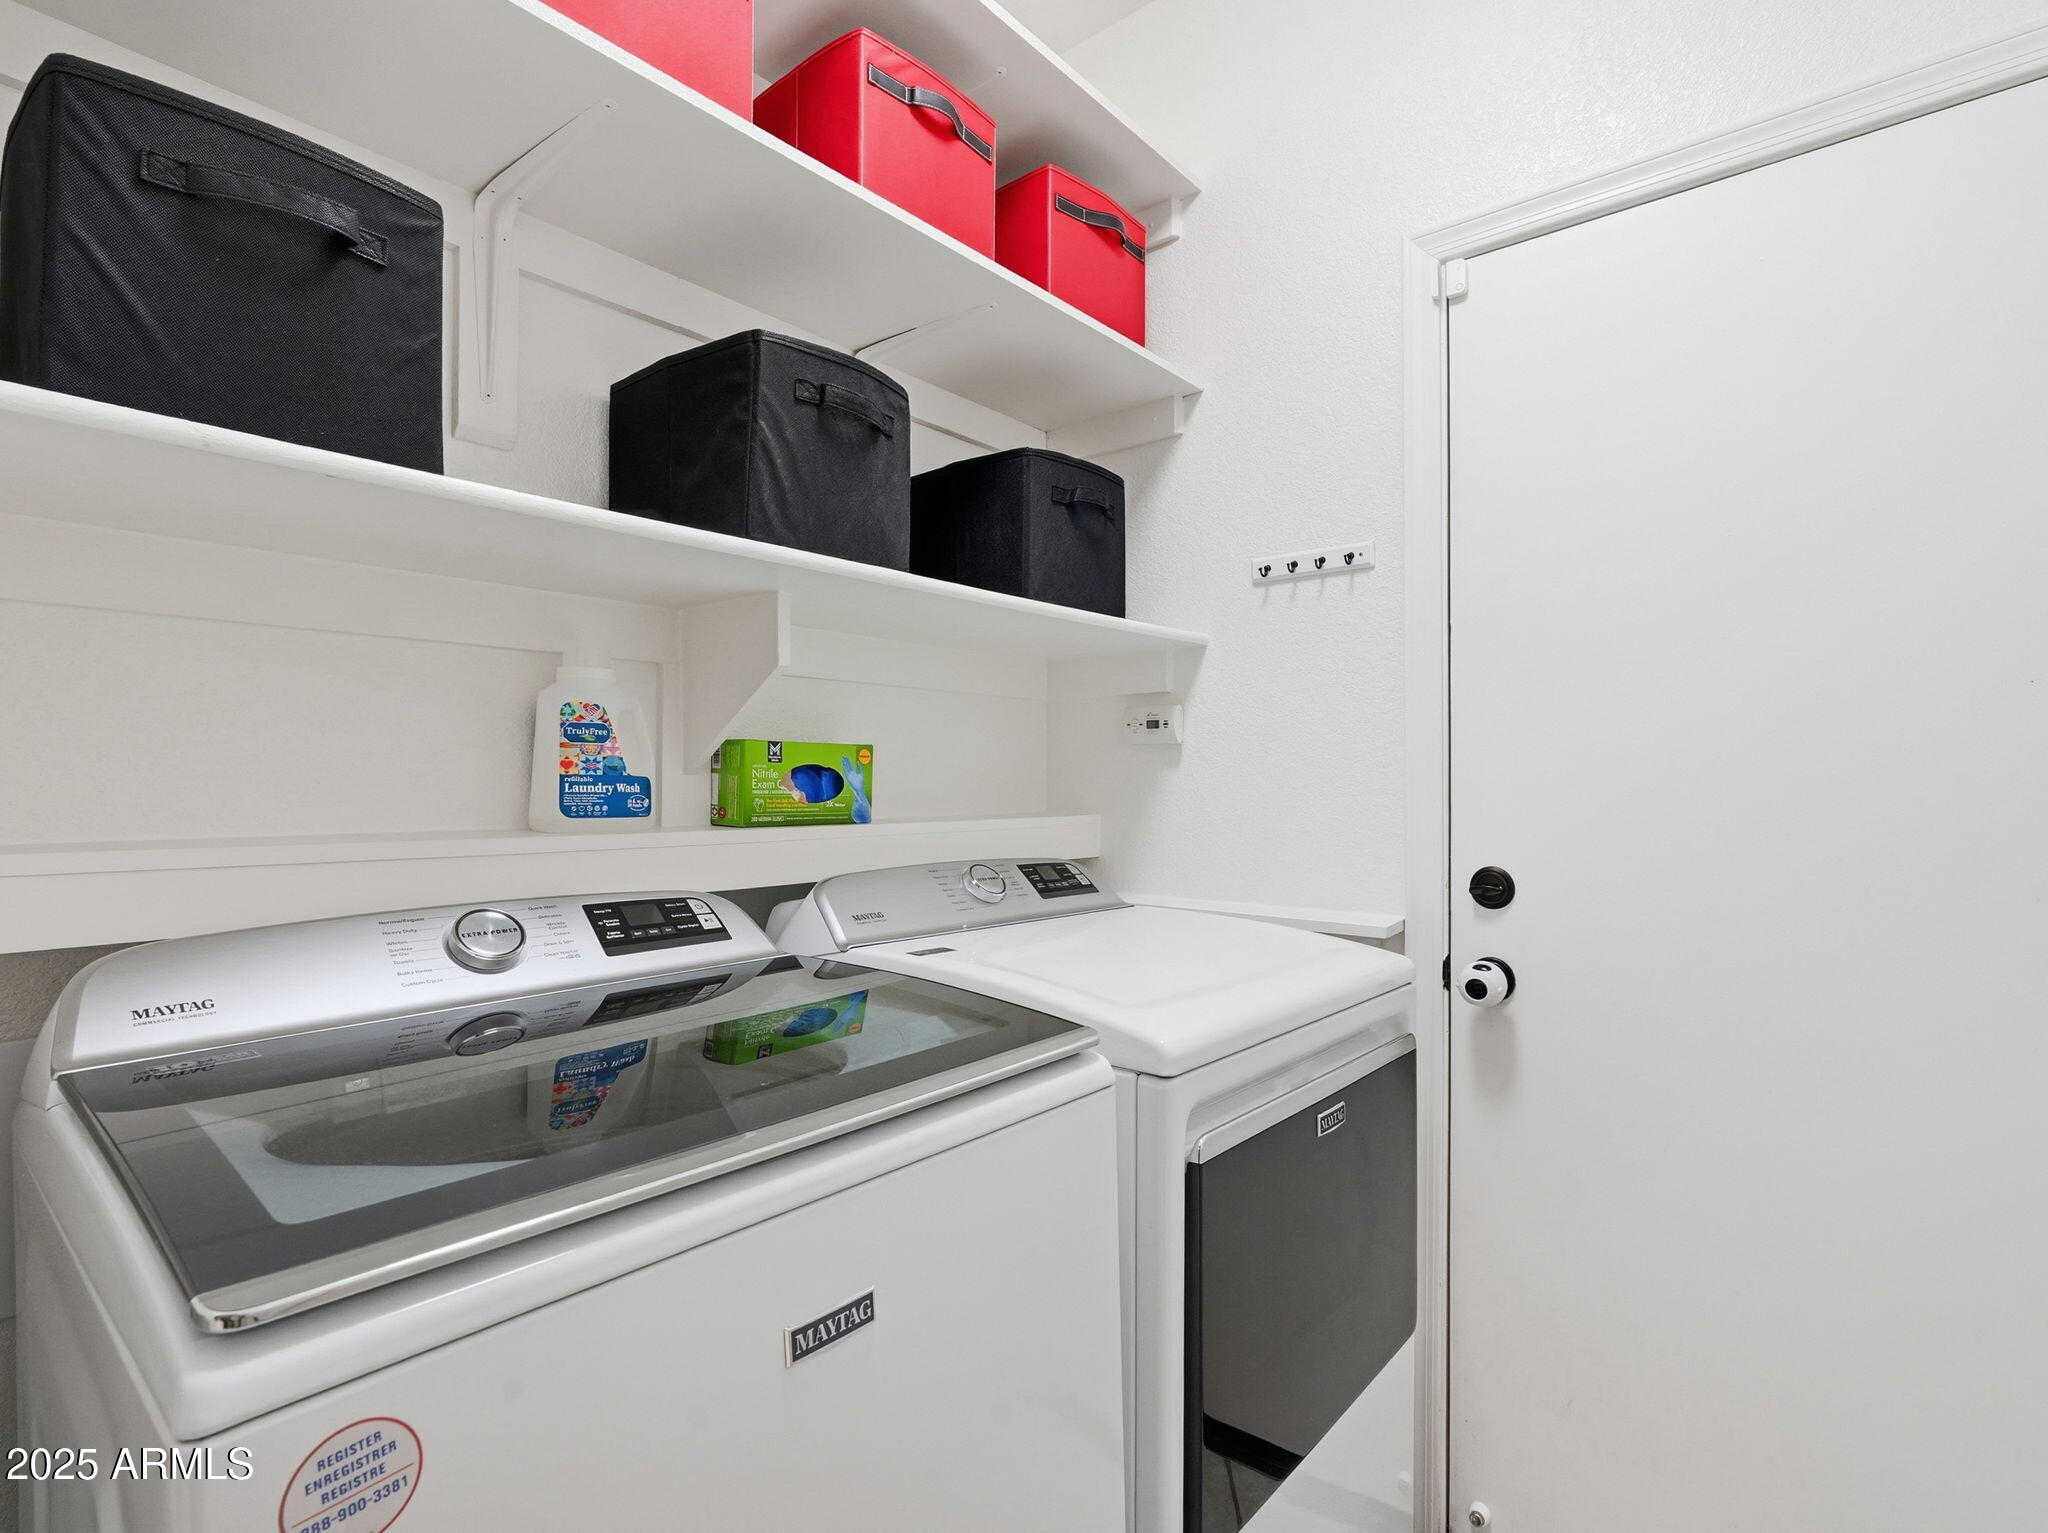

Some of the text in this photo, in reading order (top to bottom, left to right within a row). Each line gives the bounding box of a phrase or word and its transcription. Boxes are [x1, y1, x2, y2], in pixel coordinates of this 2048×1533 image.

[566, 727, 608, 736] TrulyFree
[752, 769, 779, 779] Nitrile
[564, 783, 640, 796] Laundry Wash
[752, 779, 772, 789] Exam
[851, 911, 885, 922] MAYTAG
[461, 927, 519, 938] EXTRA POWER
[131, 998, 216, 1021] MAYTAG
[133, 1010, 217, 1027] COMMERCIAL TECHNOLOGY
[794, 1300, 872, 1355] MAYTAG
[316, 1430, 382, 1472] REGISTER
[304, 1440, 397, 1496] ENREGISTRER
[321, 1462, 387, 1505] REGISTRE
